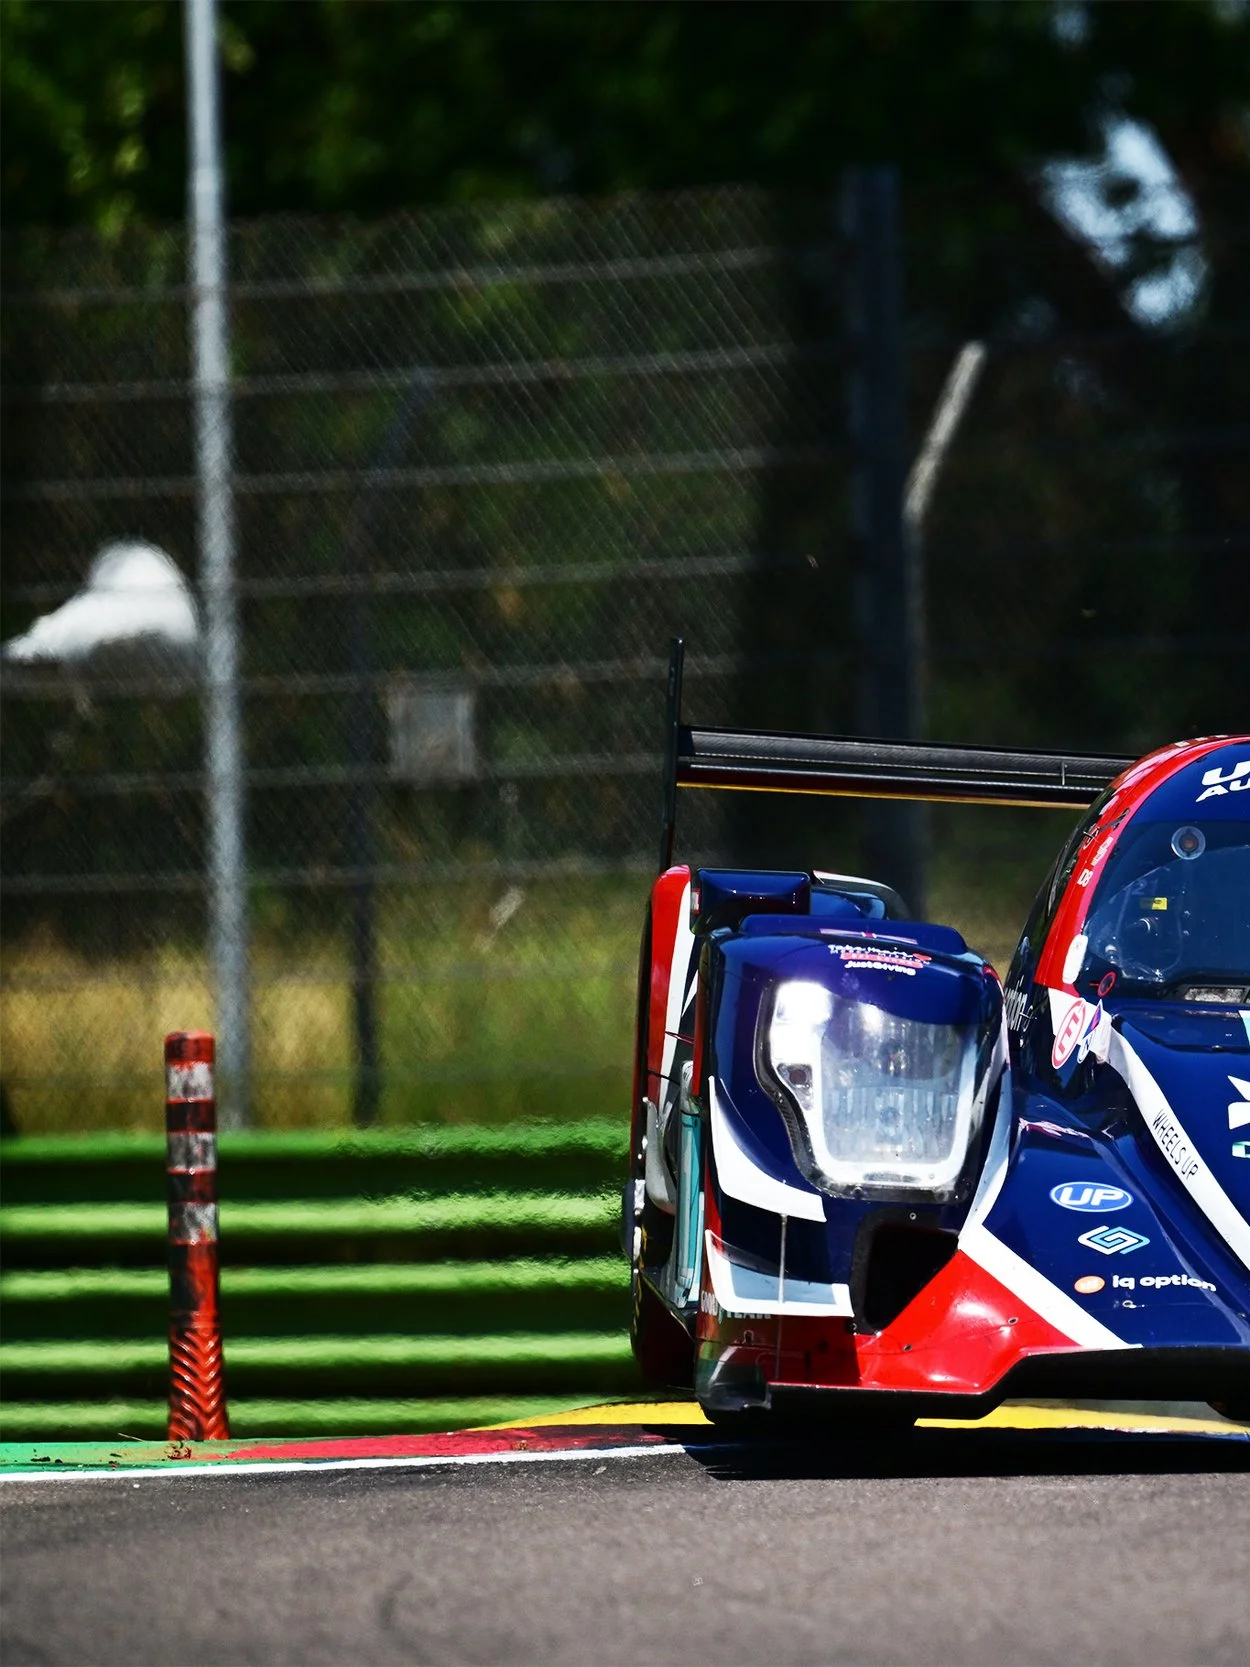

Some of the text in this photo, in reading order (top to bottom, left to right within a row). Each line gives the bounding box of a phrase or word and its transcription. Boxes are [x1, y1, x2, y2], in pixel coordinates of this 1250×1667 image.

[844, 961, 916, 976] JustGiving
[1153, 1108, 1198, 1180] WHEELS UP
[1060, 1187, 1124, 1206] UP
[1112, 1274, 1217, 1292] iq option
